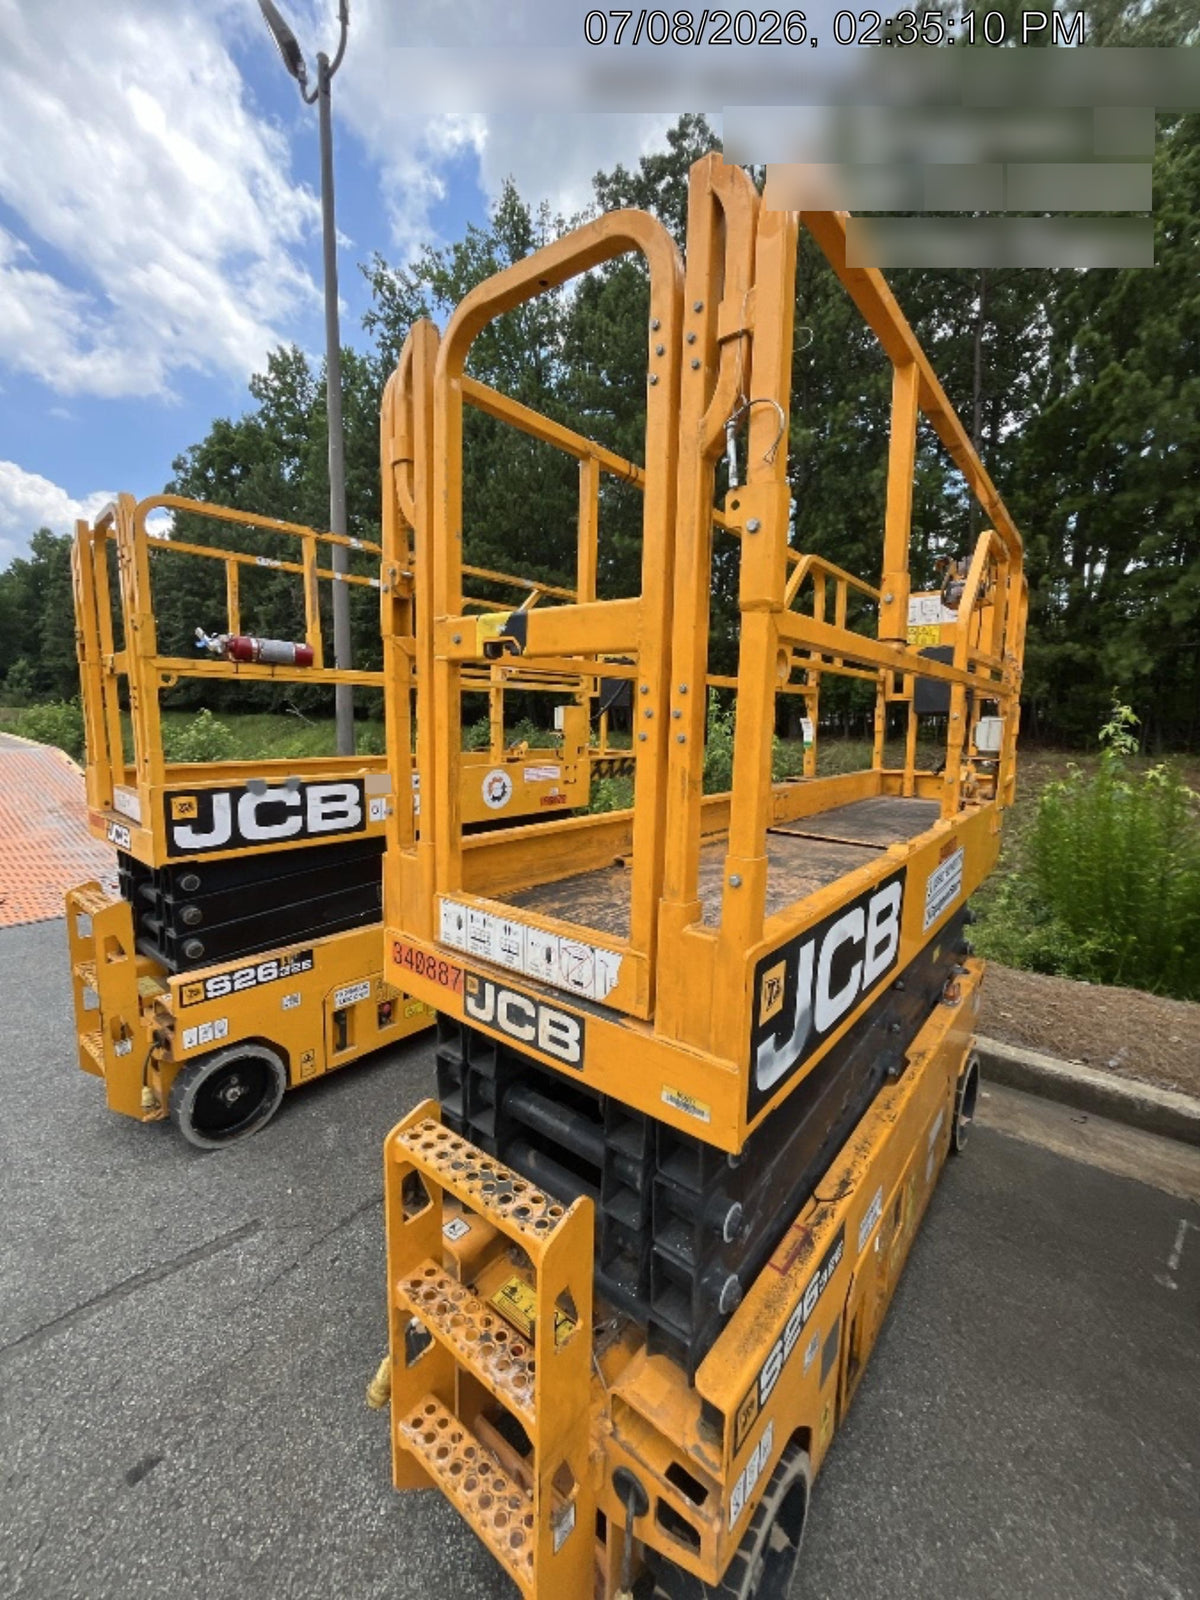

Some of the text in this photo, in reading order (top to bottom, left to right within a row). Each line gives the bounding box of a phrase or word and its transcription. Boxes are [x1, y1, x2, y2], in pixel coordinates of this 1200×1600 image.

[173, 783, 362, 850] JCB
[205, 960, 279, 999] S26
[392, 940, 462, 992] 340887
[757, 880, 902, 1092] JCB
[466, 982, 581, 1063] JCB
